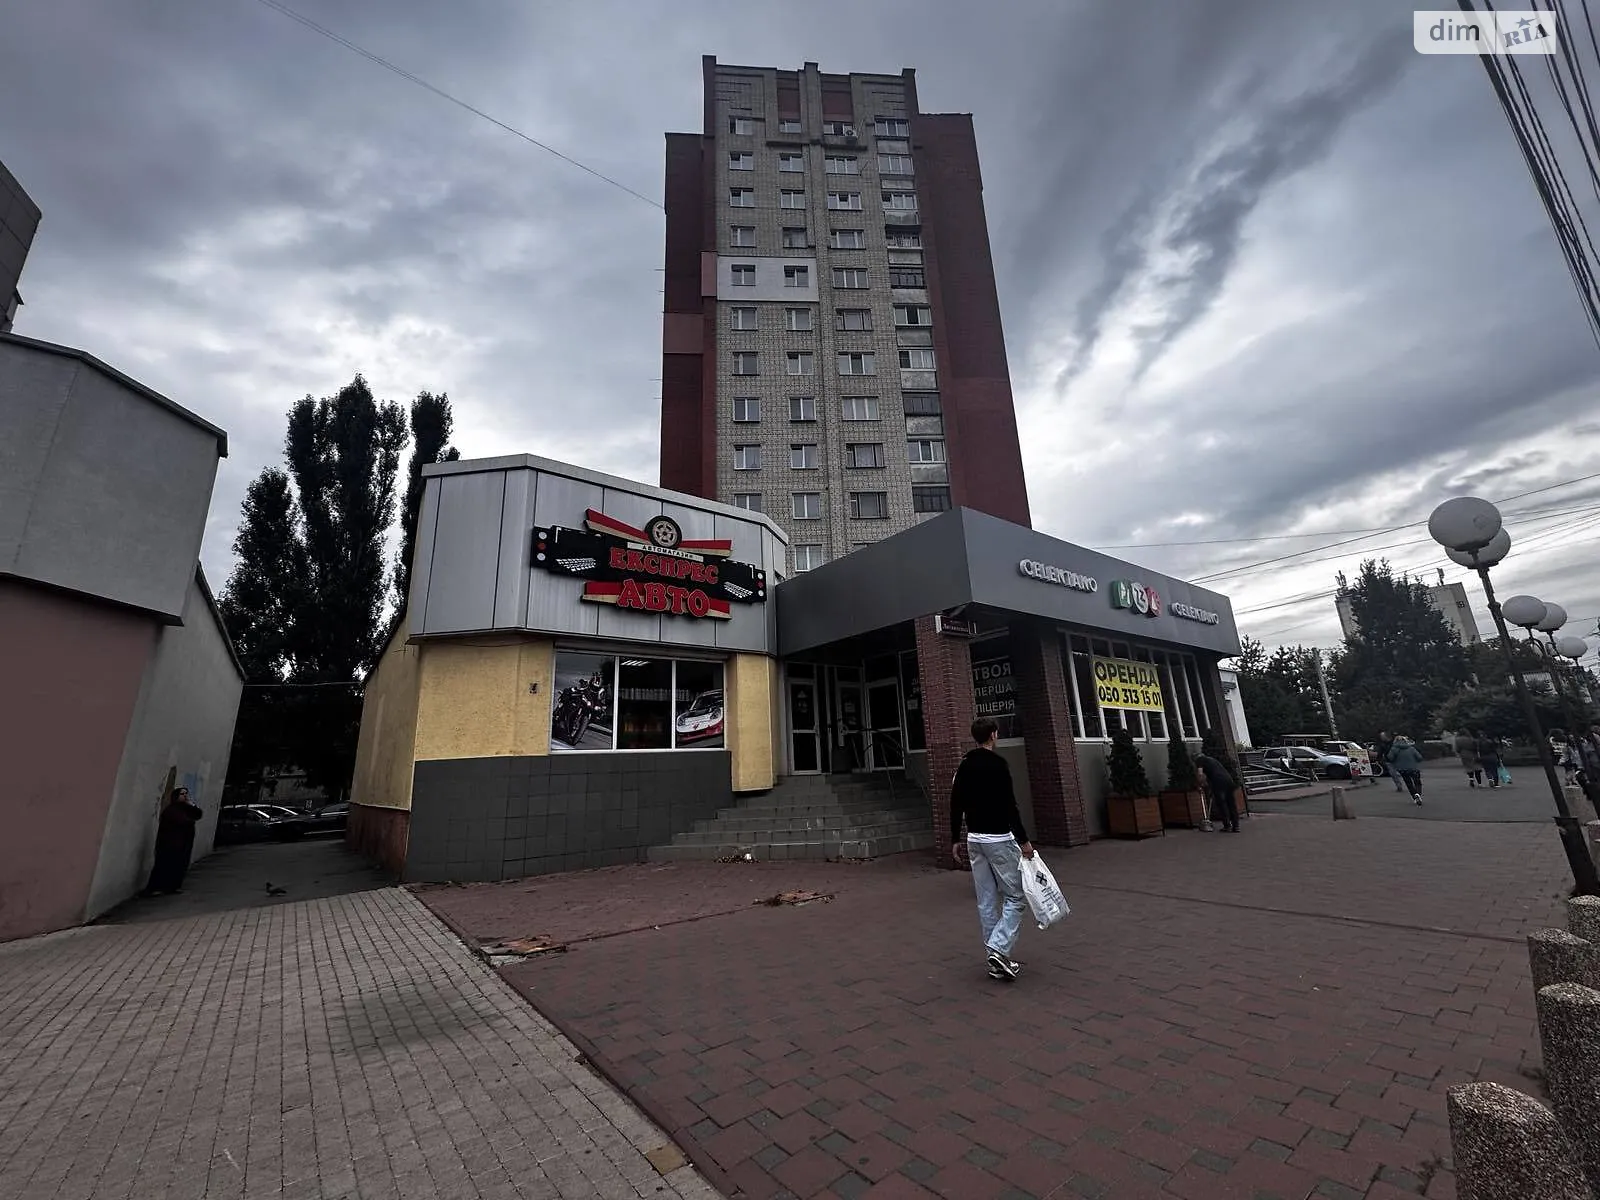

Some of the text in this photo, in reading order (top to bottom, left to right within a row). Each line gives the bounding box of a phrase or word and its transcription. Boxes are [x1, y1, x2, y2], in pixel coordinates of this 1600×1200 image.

[642, 544, 694, 559] АВТОМАГАЗИН
[609, 546, 719, 584] ЕКСПРЕС
[1019, 558, 1098, 592] CELENTANO
[617, 578, 710, 617] АВТО
[1171, 602, 1219, 625] CELENTANO
[973, 662, 1012, 681] ТВОЯ
[1095, 661, 1158, 688] ОРЕНДА
[974, 681, 1014, 697] ПЕРША
[1098, 685, 1162, 706] 050 313 15 01
[975, 698, 1016, 713] ПІЦЕРІЯ
